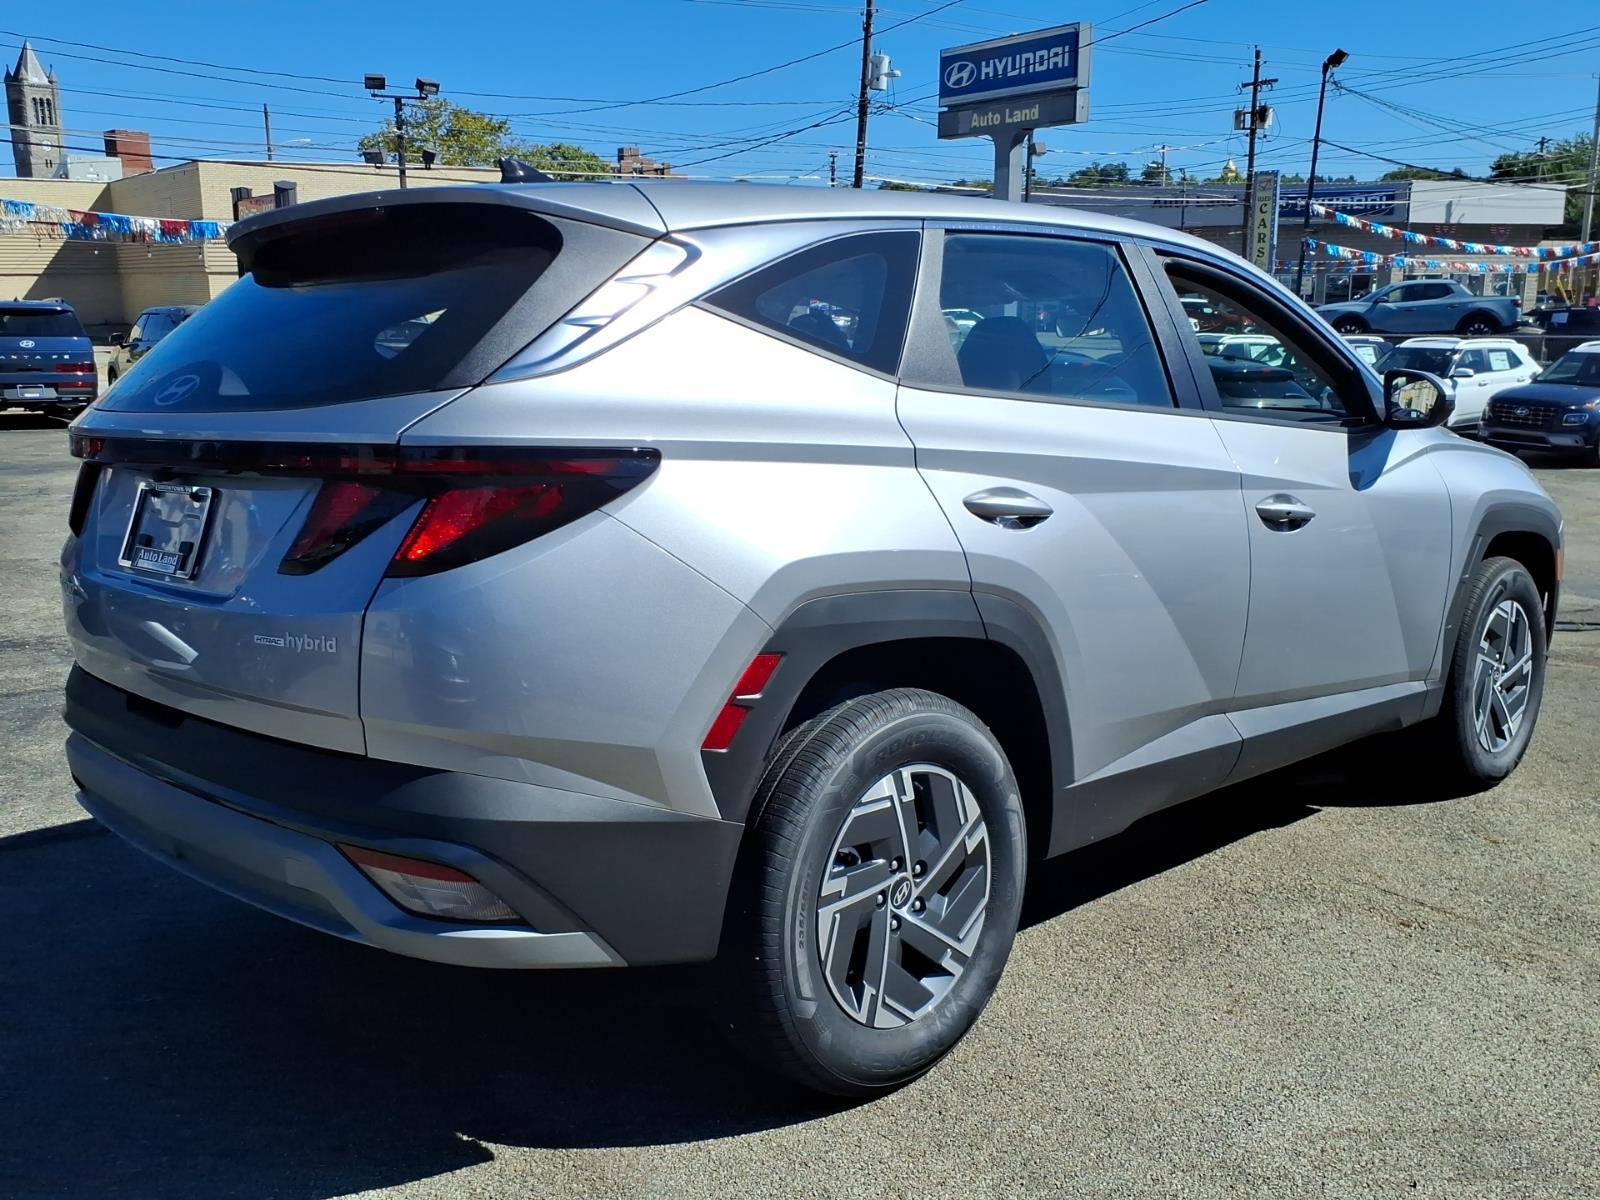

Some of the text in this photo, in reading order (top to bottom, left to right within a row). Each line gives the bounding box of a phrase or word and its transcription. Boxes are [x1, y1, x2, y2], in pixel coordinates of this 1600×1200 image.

[981, 45, 1070, 80] HYUNDAI
[971, 104, 1040, 129] Auto Land
[1256, 202, 1268, 258] CARS
[139, 549, 179, 565] Auto Land
[286, 632, 337, 653] hybrid
